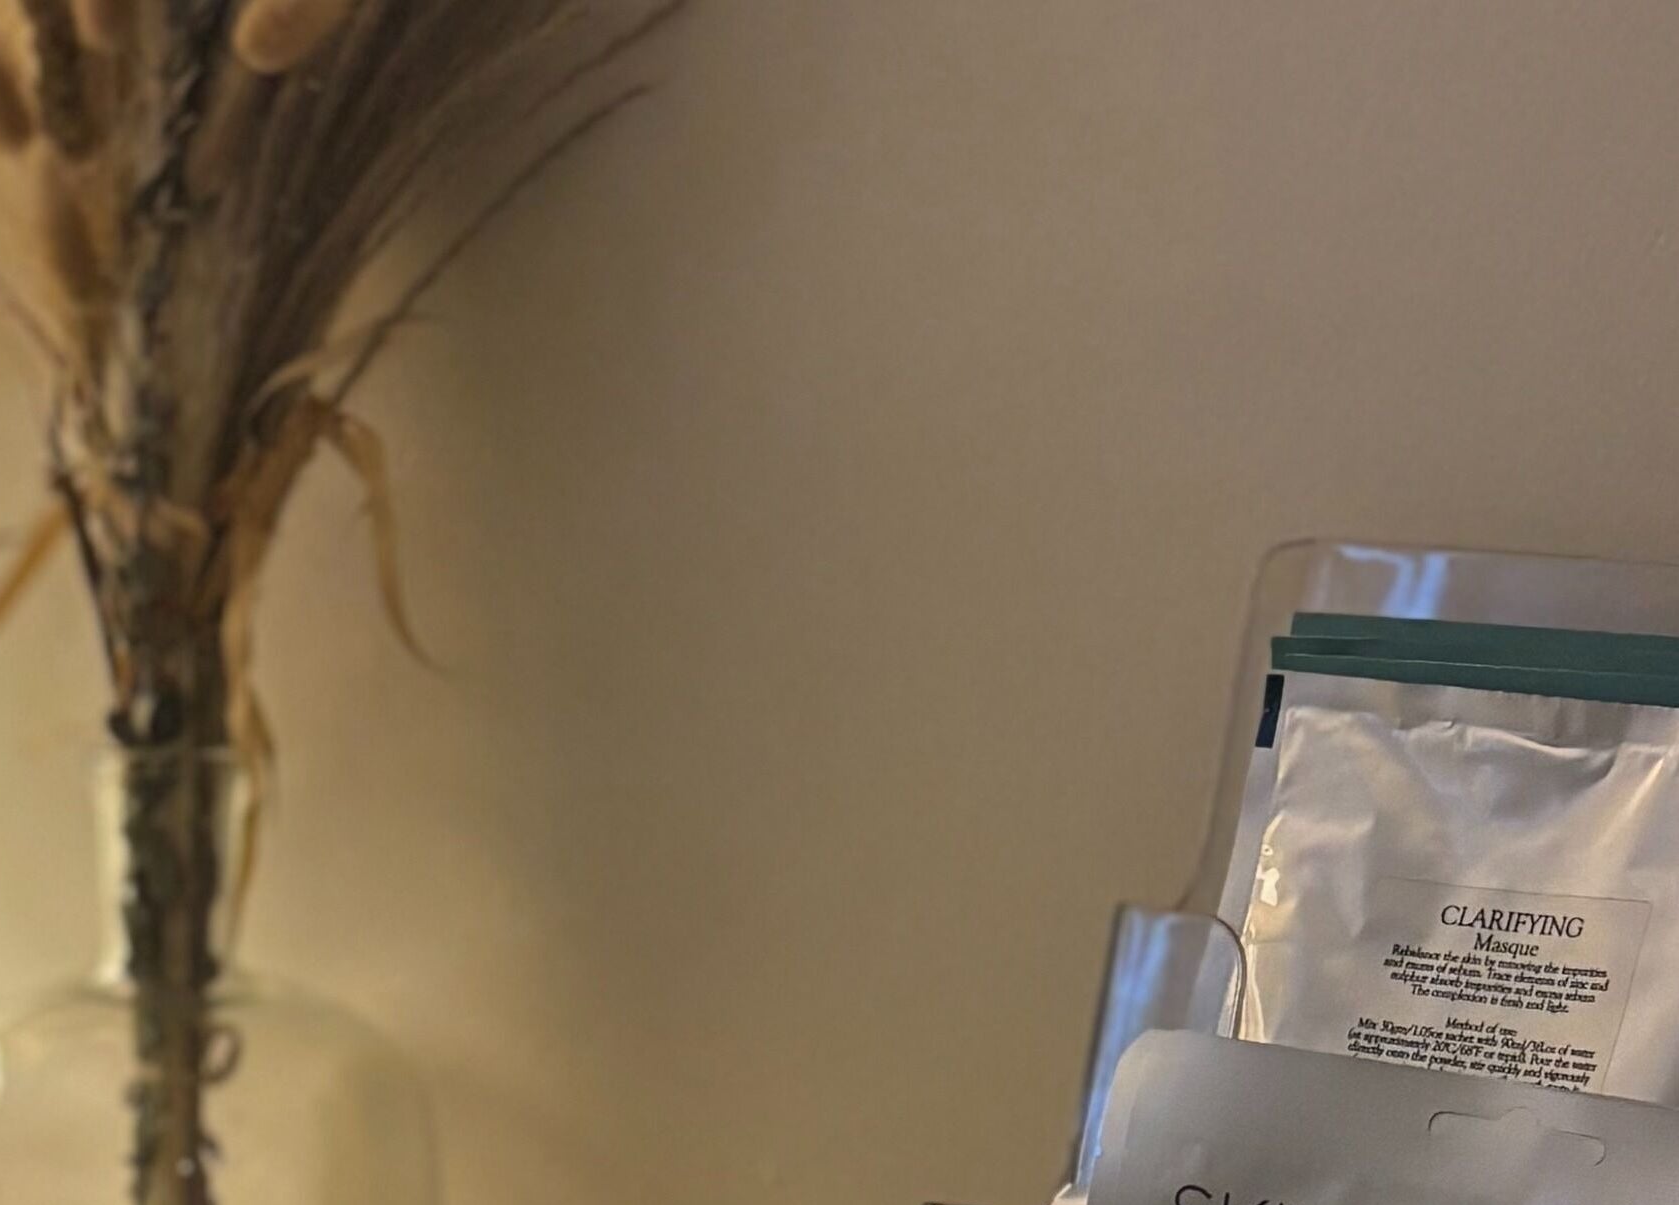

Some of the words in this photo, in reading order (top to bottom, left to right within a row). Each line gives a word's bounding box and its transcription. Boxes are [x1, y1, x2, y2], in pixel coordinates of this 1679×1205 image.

[1441, 905, 1585, 938] CLARIFYING
[1474, 933, 1540, 958] Masque
[1436, 963, 1447, 973] of
[1557, 976, 1569, 987] of
[1410, 983, 1430, 996] The
